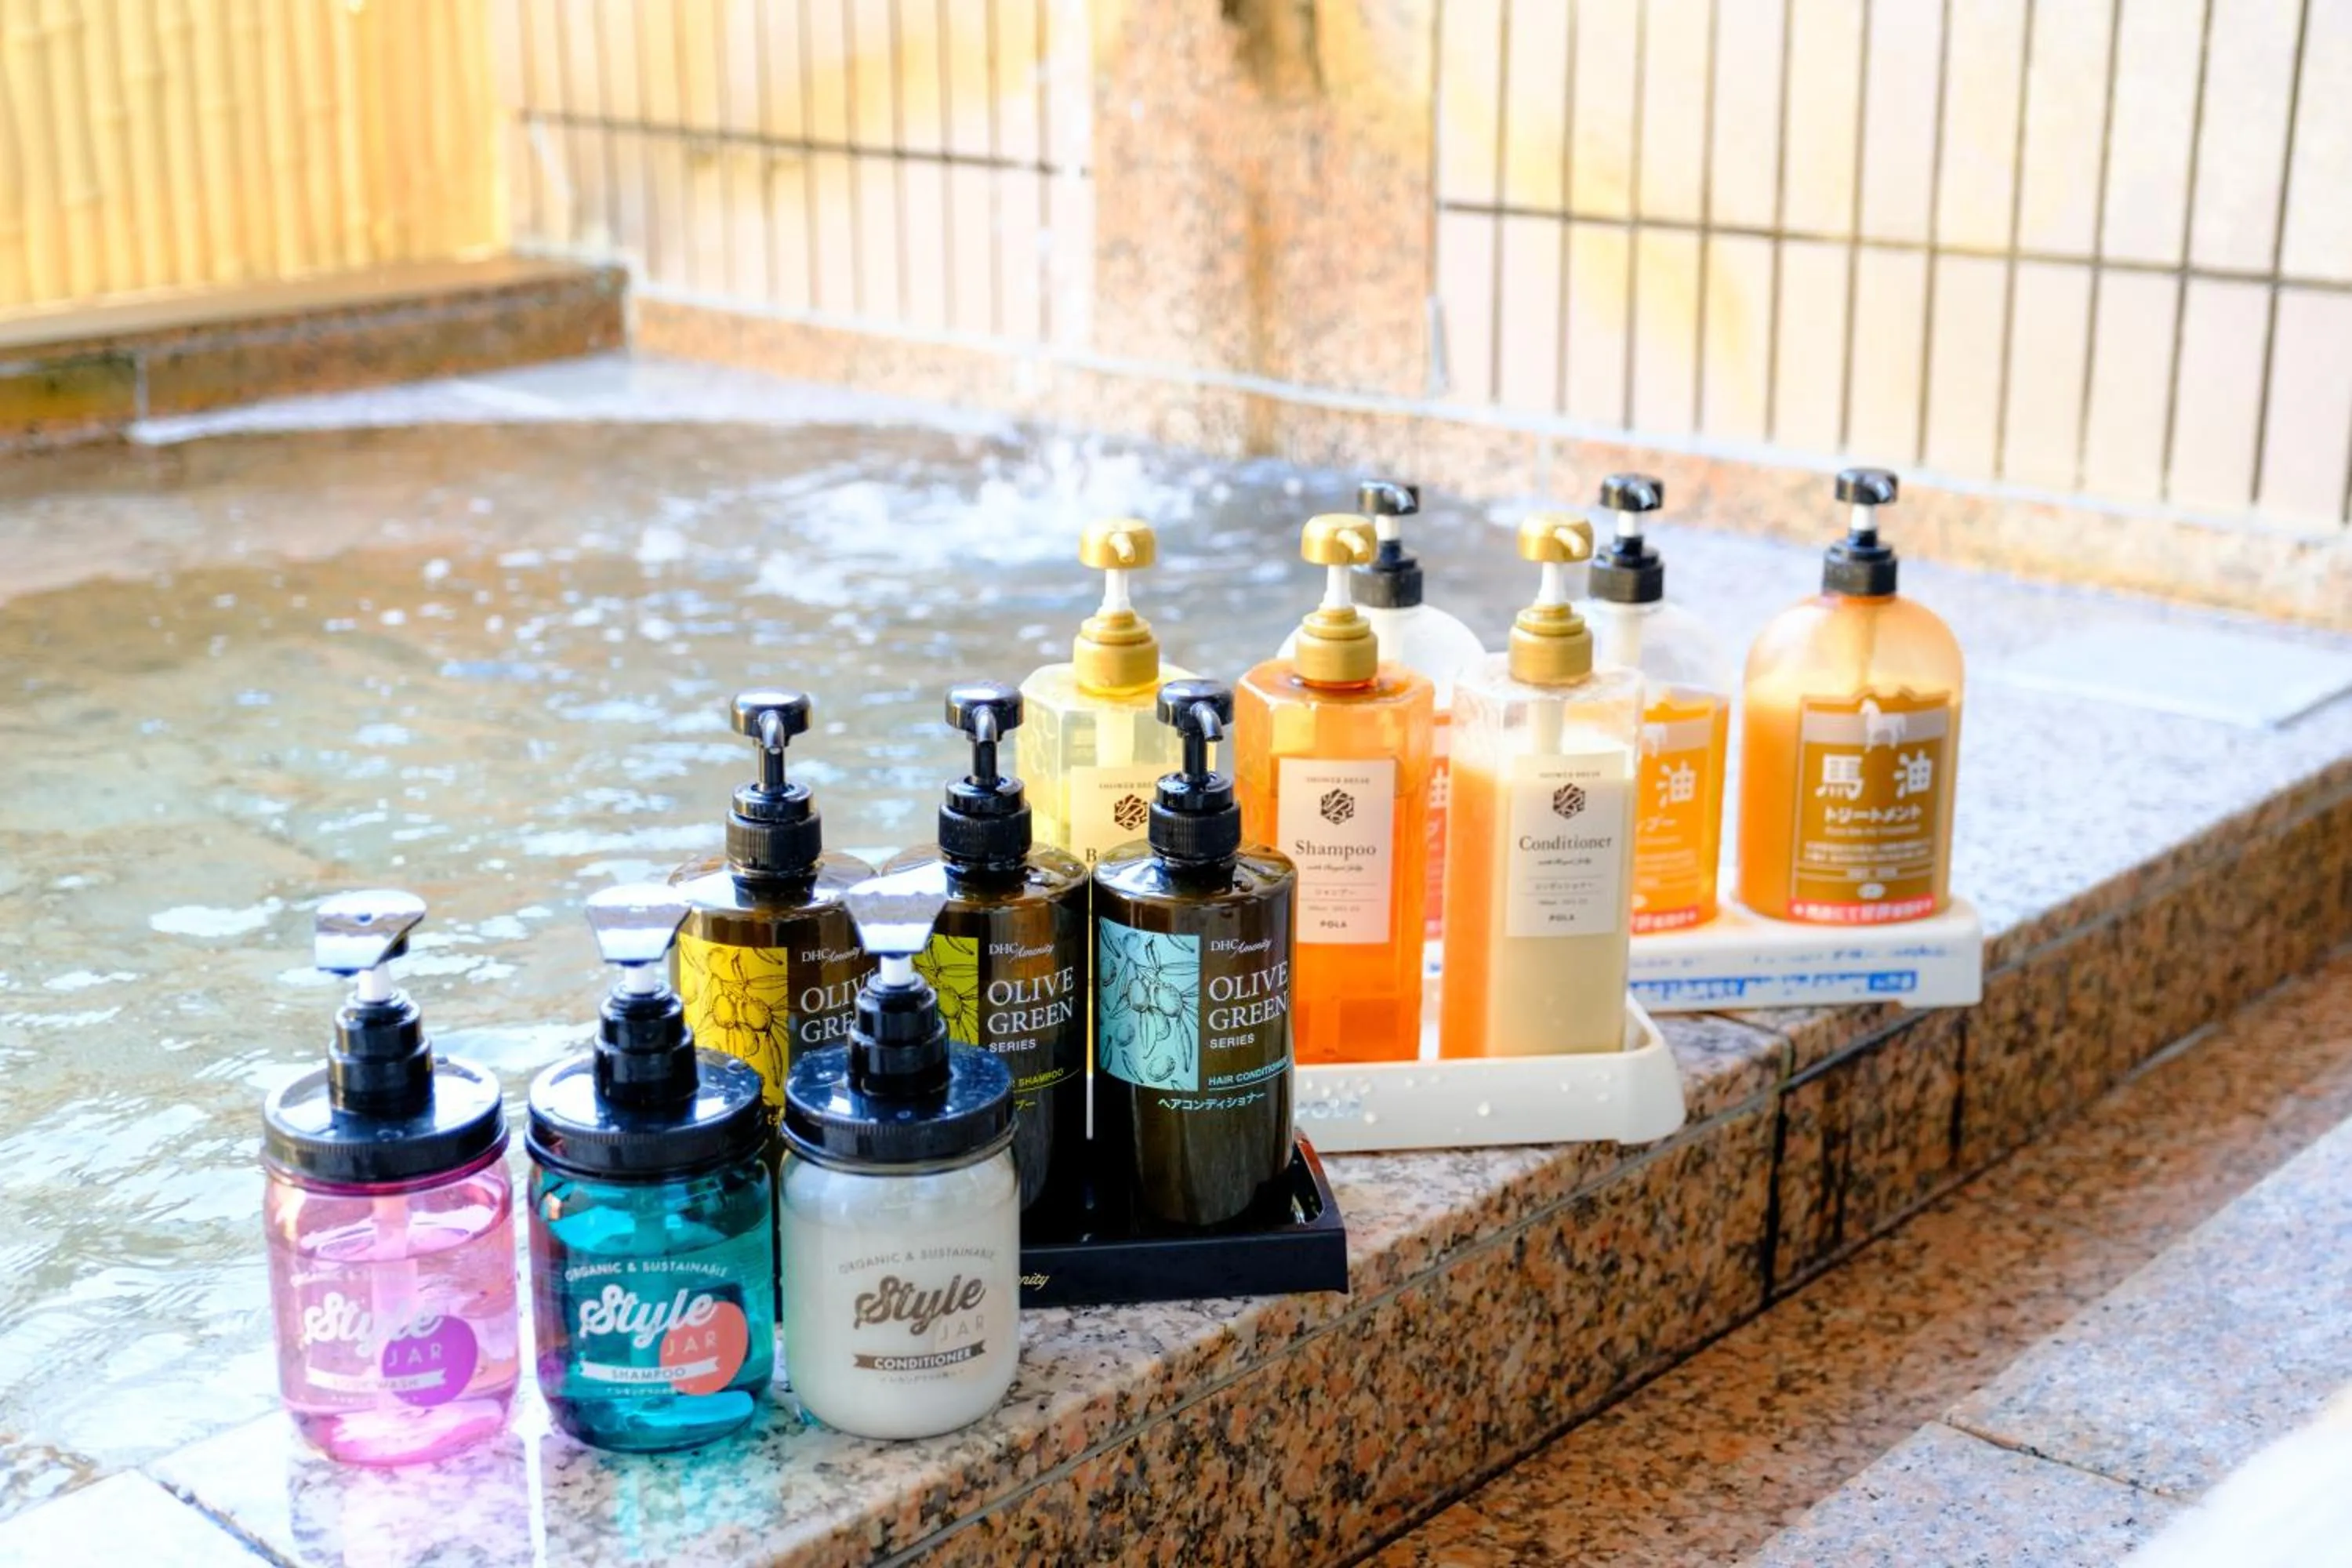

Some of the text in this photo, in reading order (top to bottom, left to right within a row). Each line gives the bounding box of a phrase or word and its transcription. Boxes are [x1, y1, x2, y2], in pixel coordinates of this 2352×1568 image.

[1815, 750, 1933, 800] 馬 油
[1295, 840, 1377, 860] Shampoo
[1519, 835, 1612, 851] Conditioner
[802, 949, 831, 962] DHC
[989, 942, 1019, 955] DHC
[1210, 939, 1240, 951] DHC
[800, 967, 876, 1014] OLIV
[988, 966, 1073, 1006] OLIVE
[1208, 960, 1288, 1001] OLIVE
[988, 996, 1074, 1034] GREEN
[1208, 990, 1288, 1031] GREEN
[800, 1011, 856, 1043] GRE
[989, 1039, 1036, 1053] SERIES
[1210, 1033, 1254, 1049] SERIES
[1018, 1067, 1065, 1087] SHAMPOO
[1208, 1075, 1233, 1087] HAIR
[1158, 1091, 1266, 1111] ヘアコンディショナー
[564, 1262, 622, 1283] ORGANIC
[627, 1263, 637, 1272] &
[840, 1253, 901, 1274] ORGANIC
[579, 1283, 719, 1348] Style
[854, 1274, 986, 1336] Style
[304, 1292, 445, 1357] Style
[942, 1315, 985, 1341] JAR
[666, 1330, 717, 1357] JAR
[387, 1343, 444, 1368] JAR
[874, 1348, 971, 1370] CONDITIONER
[612, 1367, 686, 1381] SHAMPOO
